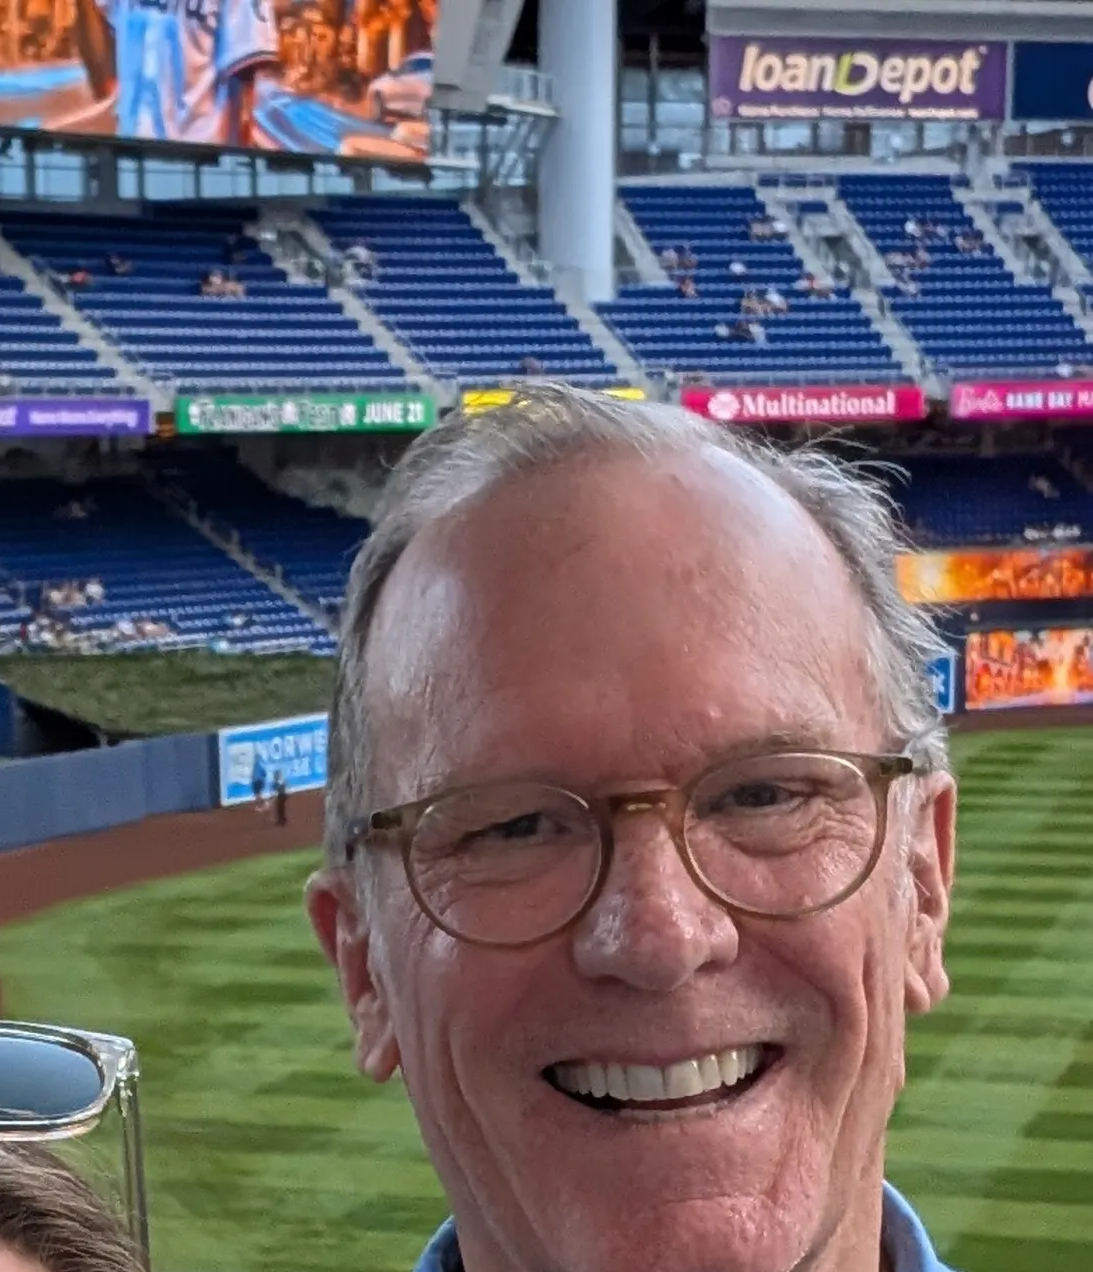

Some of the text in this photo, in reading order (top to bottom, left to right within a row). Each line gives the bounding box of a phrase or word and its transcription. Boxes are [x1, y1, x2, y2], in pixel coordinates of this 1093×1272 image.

[738, 43, 981, 104] loanDepot
[363, 400, 404, 424] JUNE
[742, 389, 896, 420] Multinational
[254, 729, 328, 764] NORWE
